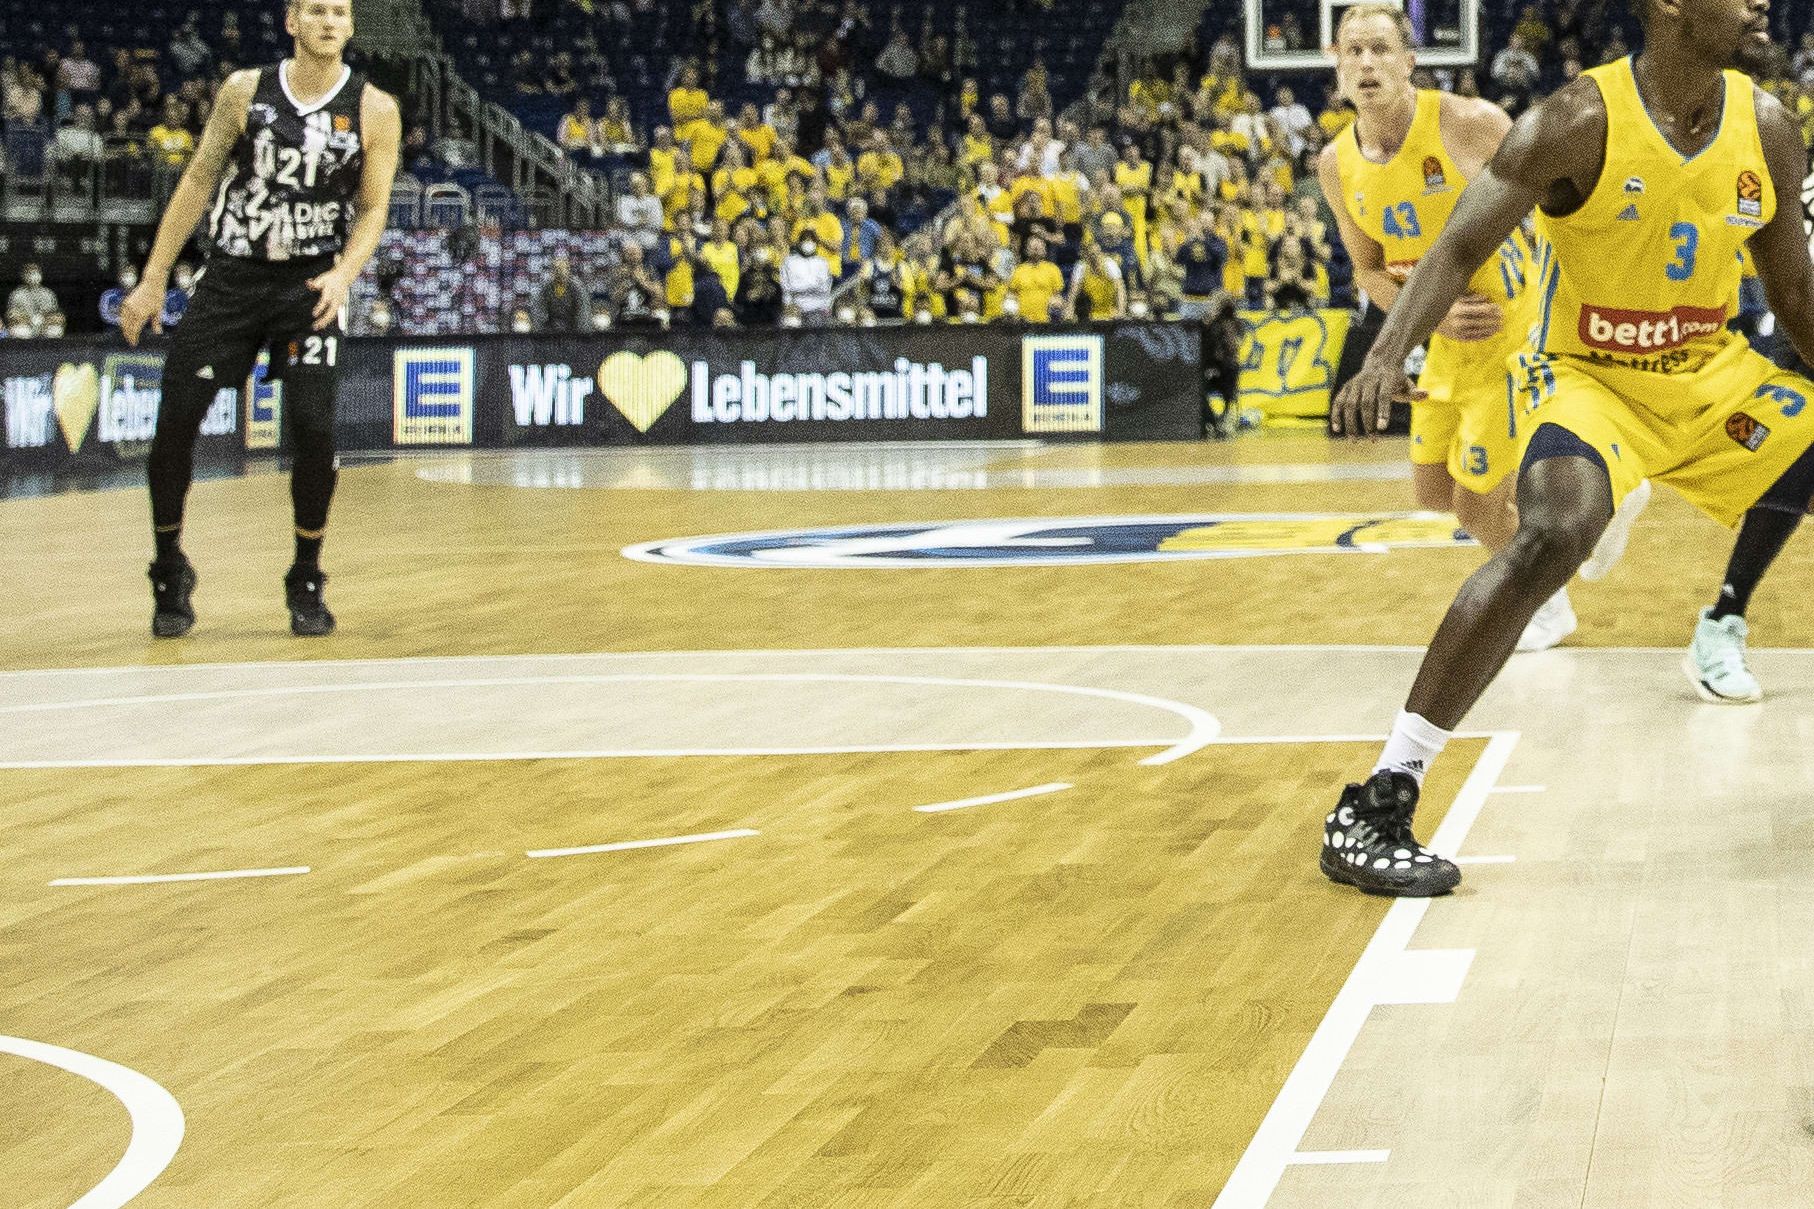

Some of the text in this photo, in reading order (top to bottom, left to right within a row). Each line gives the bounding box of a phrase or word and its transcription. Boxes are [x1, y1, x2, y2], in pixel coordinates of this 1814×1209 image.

[276, 147, 318, 188] 21
[1382, 201, 1421, 239] 43
[1665, 222, 1699, 281] 3
[305, 337, 338, 367] 21
[405, 360, 461, 418] E
[508, 356, 988, 427] Wir Lebensmittel
[1034, 349, 1090, 406] E
[1755, 383, 1806, 418] 3
